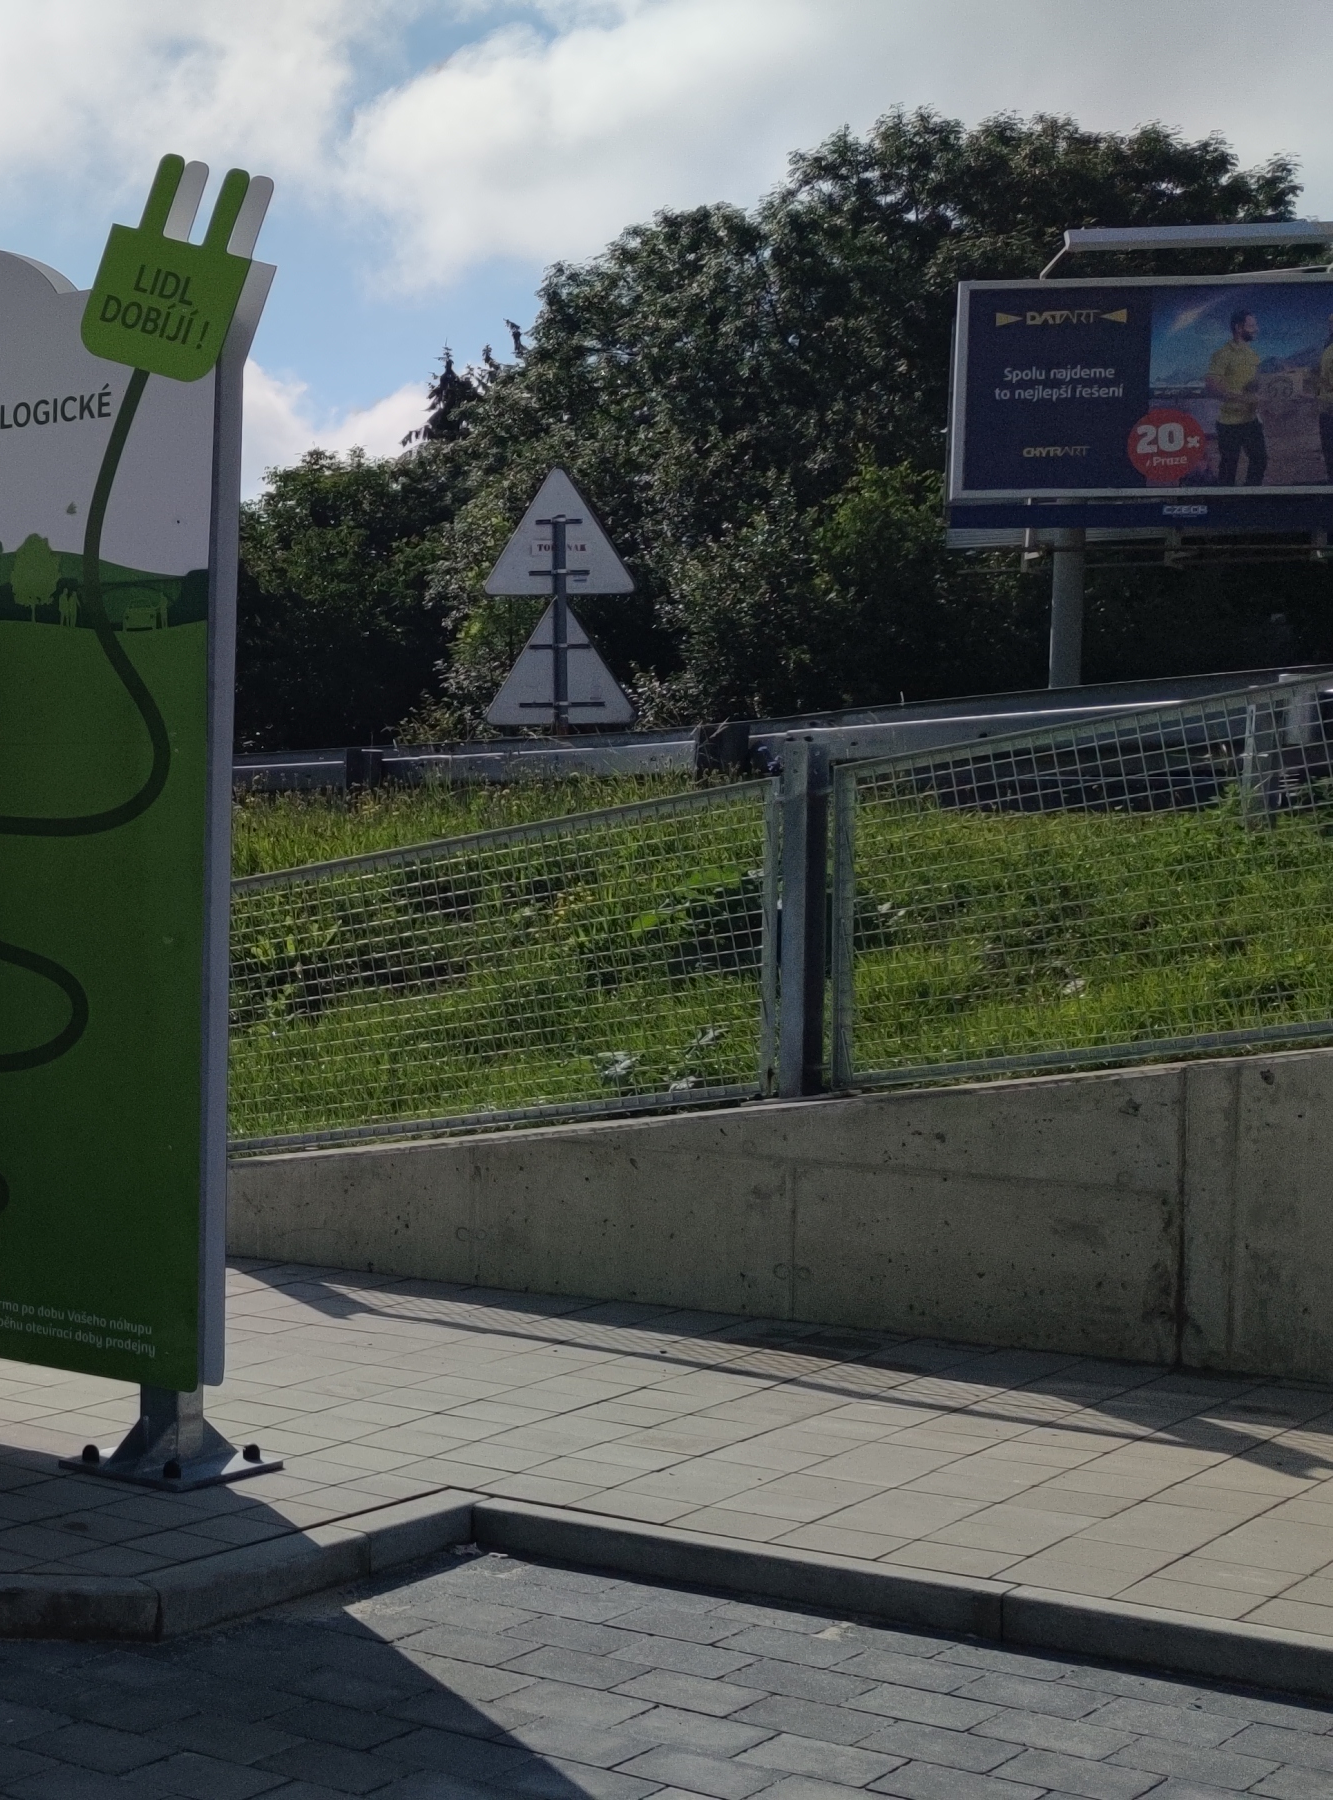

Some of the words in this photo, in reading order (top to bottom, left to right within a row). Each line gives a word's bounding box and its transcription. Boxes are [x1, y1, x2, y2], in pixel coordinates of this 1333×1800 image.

[133, 264, 192, 306] LIDL
[99, 294, 199, 345] DOBÍJÍ
[1026, 309, 1101, 325] DATART
[1003, 366, 1046, 383] Spolu
[1050, 365, 1116, 381] najdeme
[994, 387, 1010, 400] to
[1014, 383, 1072, 402] nejlepší
[1075, 383, 1124, 398] řešení
[1153, 455, 1188, 467] Praze
[21, 1303, 35, 1316] po
[37, 1306, 65, 1321] dobu
[67, 1310, 107, 1328] Vašeho
[109, 1317, 152, 1337] nákupu
[25, 1322, 72, 1339] otevírací
[75, 1330, 103, 1349] doby
[105, 1337, 156, 1358] prodejny
